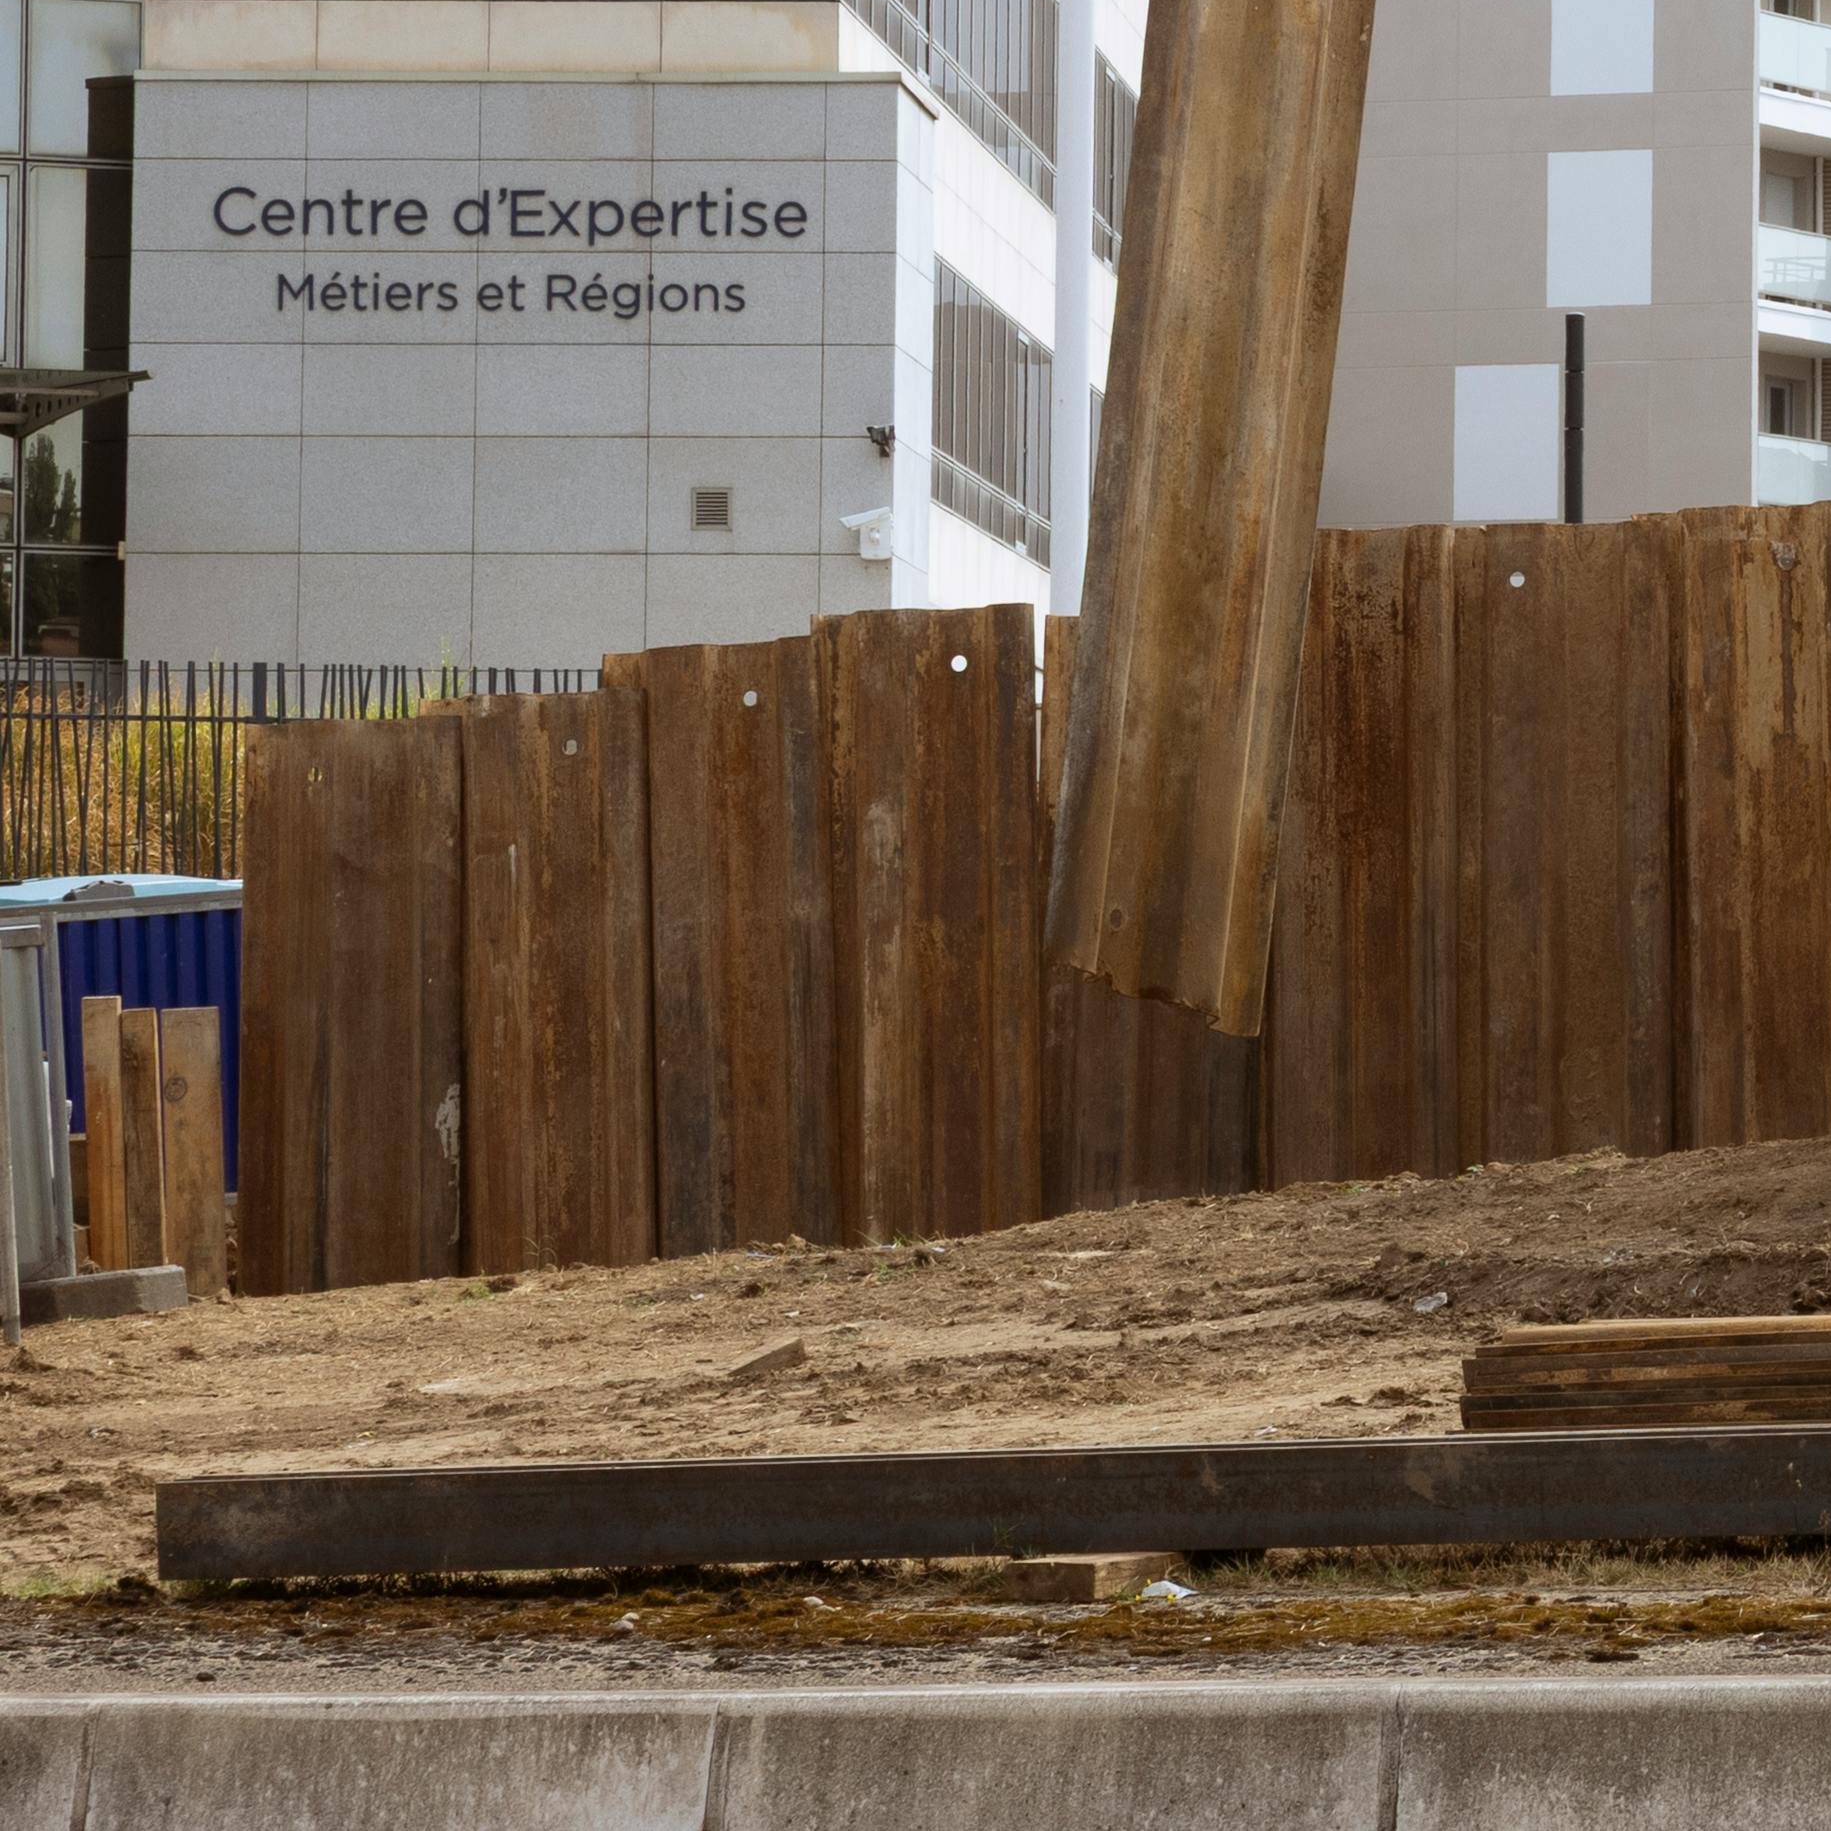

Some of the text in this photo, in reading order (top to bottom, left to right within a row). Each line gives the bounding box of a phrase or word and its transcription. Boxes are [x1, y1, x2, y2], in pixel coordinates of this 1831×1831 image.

[212, 186, 809, 246] Centre d'Expertise
[276, 271, 747, 320] Métiers et Régions
